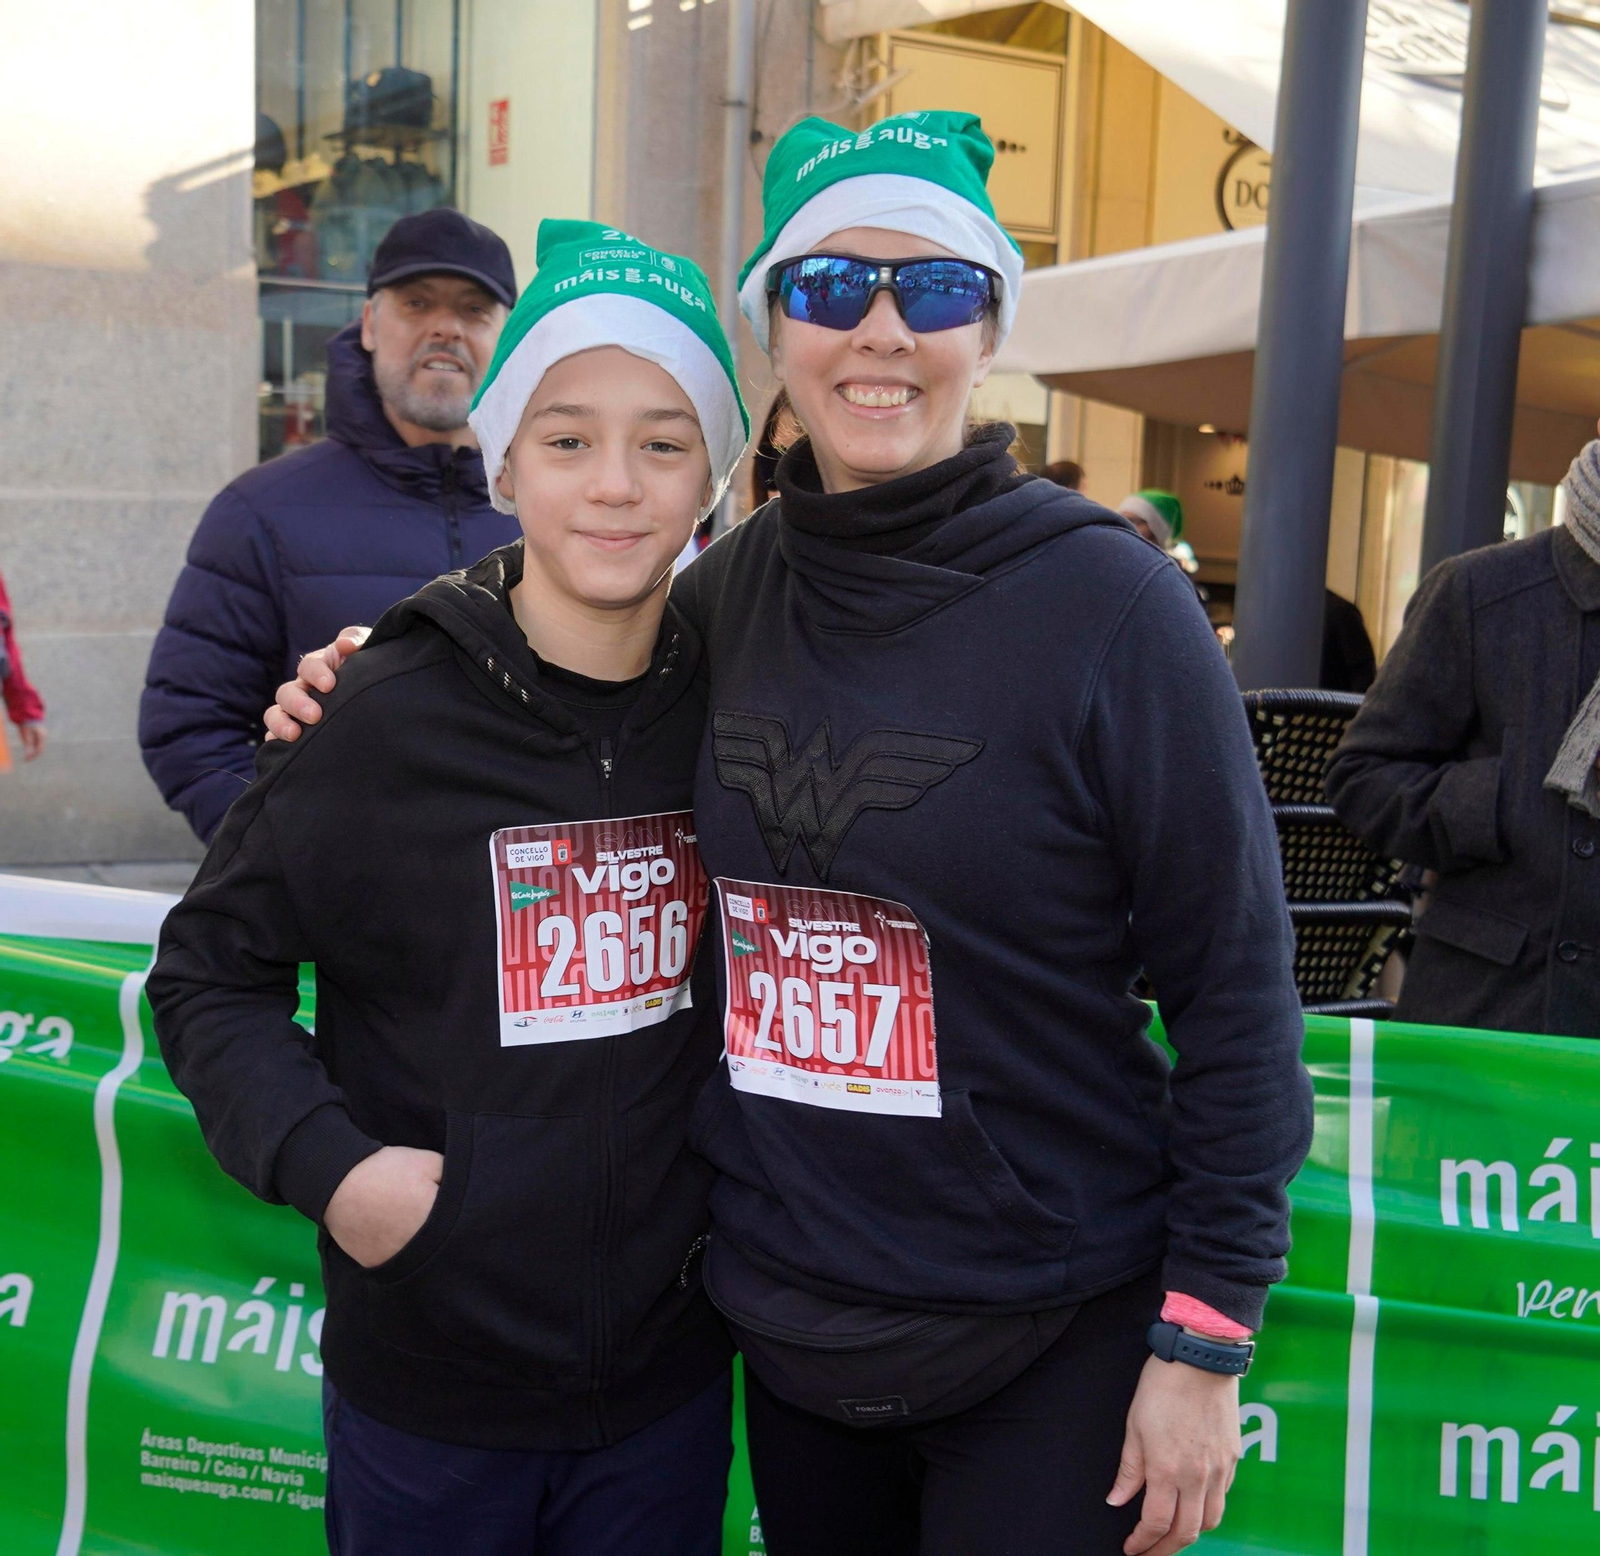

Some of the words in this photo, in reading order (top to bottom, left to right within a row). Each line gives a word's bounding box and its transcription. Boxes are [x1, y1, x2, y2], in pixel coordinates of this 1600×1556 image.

[795, 138, 852, 182] máis
[878, 127, 948, 150] auga
[1235, 179, 1269, 210] DO
[584, 250, 646, 258] CONCELLO
[554, 268, 620, 293] máis
[648, 273, 706, 312] auga
[510, 846, 549, 856] CONCELLO
[594, 827, 662, 851] SAN
[527, 854, 545, 862] VIGO
[596, 845, 663, 863] SILVESTRE
[572, 857, 676, 901] vigo
[787, 899, 858, 923] SAN
[788, 917, 861, 933] SILVESTRE
[537, 900, 688, 998] 2656
[769, 928, 877, 974] vigo
[749, 970, 901, 1067] 2657
[847, 1083, 871, 1094] GADIS
[855, 1404, 893, 1412] FORCLAZ
[140, 1427, 183, 1451] Áreas
[186, 1436, 265, 1462] Deportivas
[140, 1451, 200, 1473] Barreiro
[213, 1459, 247, 1479] Coia
[262, 1466, 304, 1487] Navia
[140, 1471, 274, 1500] maisqueauga.com
